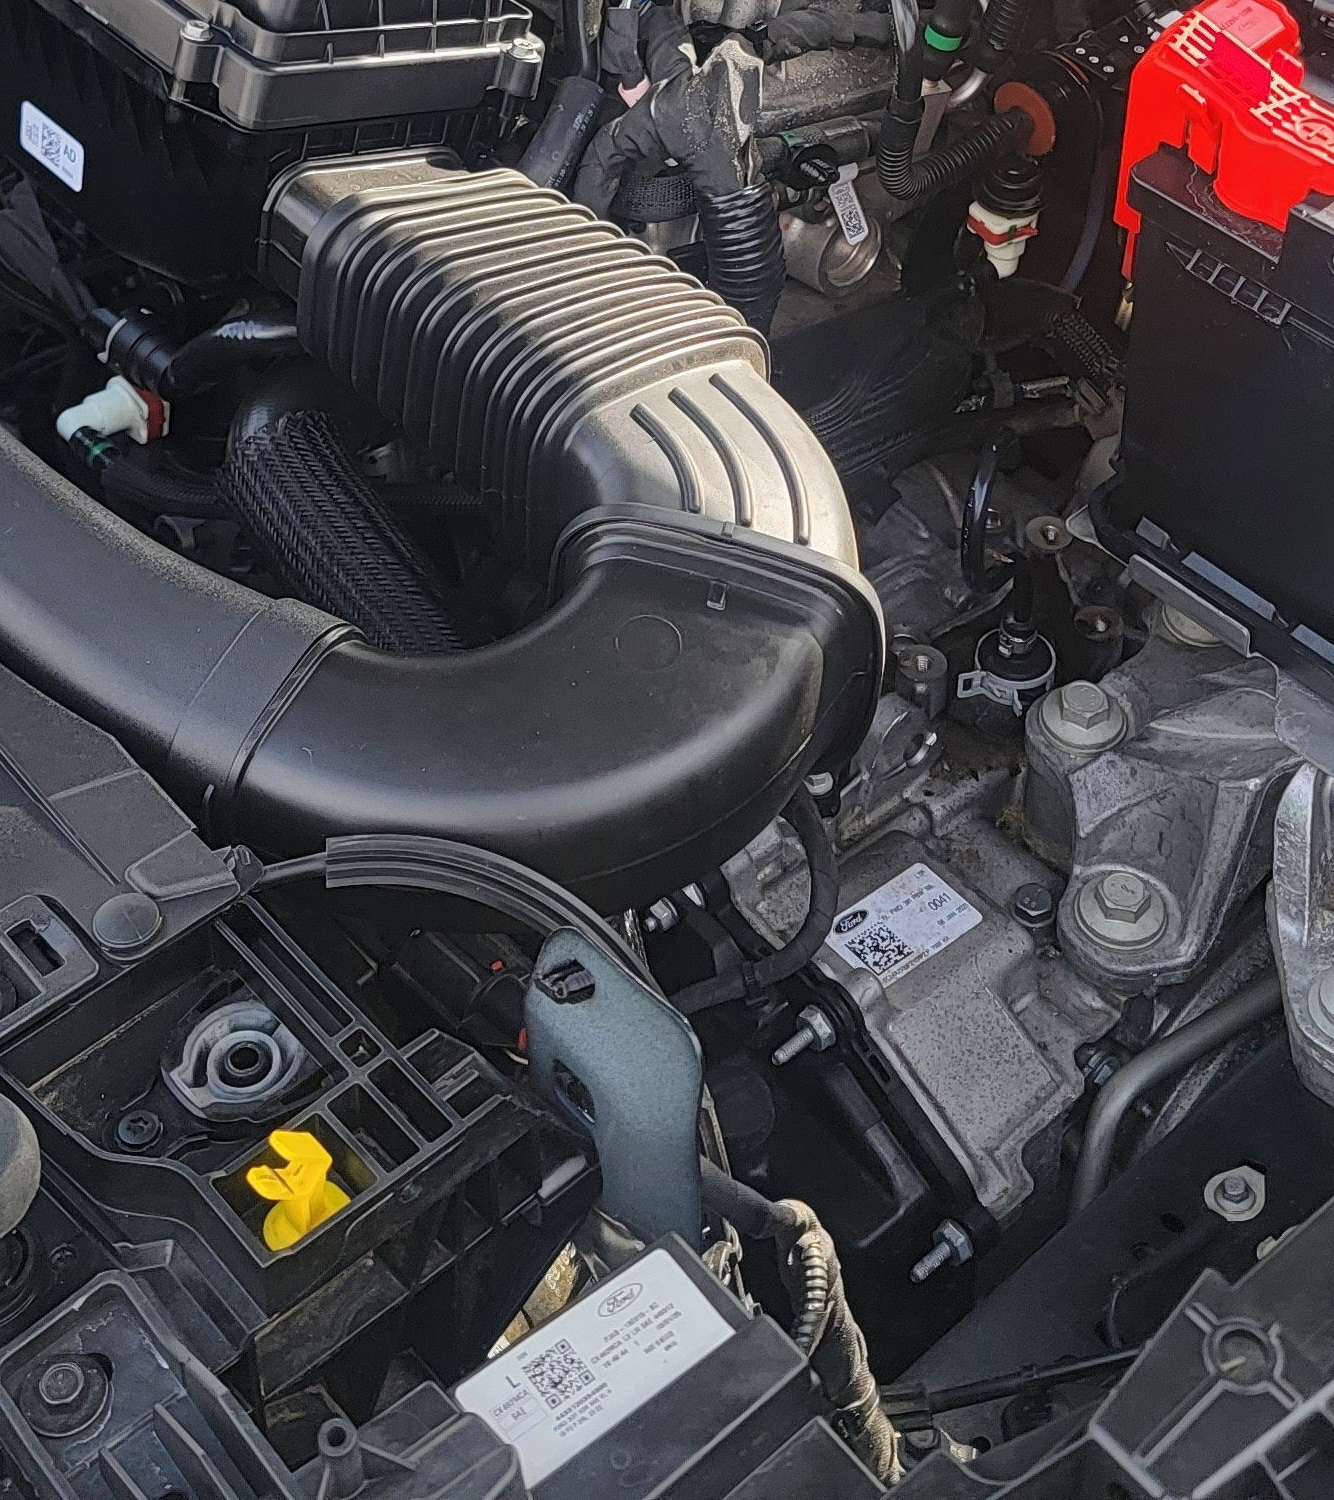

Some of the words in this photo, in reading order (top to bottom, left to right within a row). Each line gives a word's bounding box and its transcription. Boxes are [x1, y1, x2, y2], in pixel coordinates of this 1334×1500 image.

[63, 143, 75, 165] AD
[925, 891, 952, 912] 0041
[837, 912, 862, 932] Ford
[605, 1289, 636, 1313] Ford
[505, 1374, 521, 1389] L
